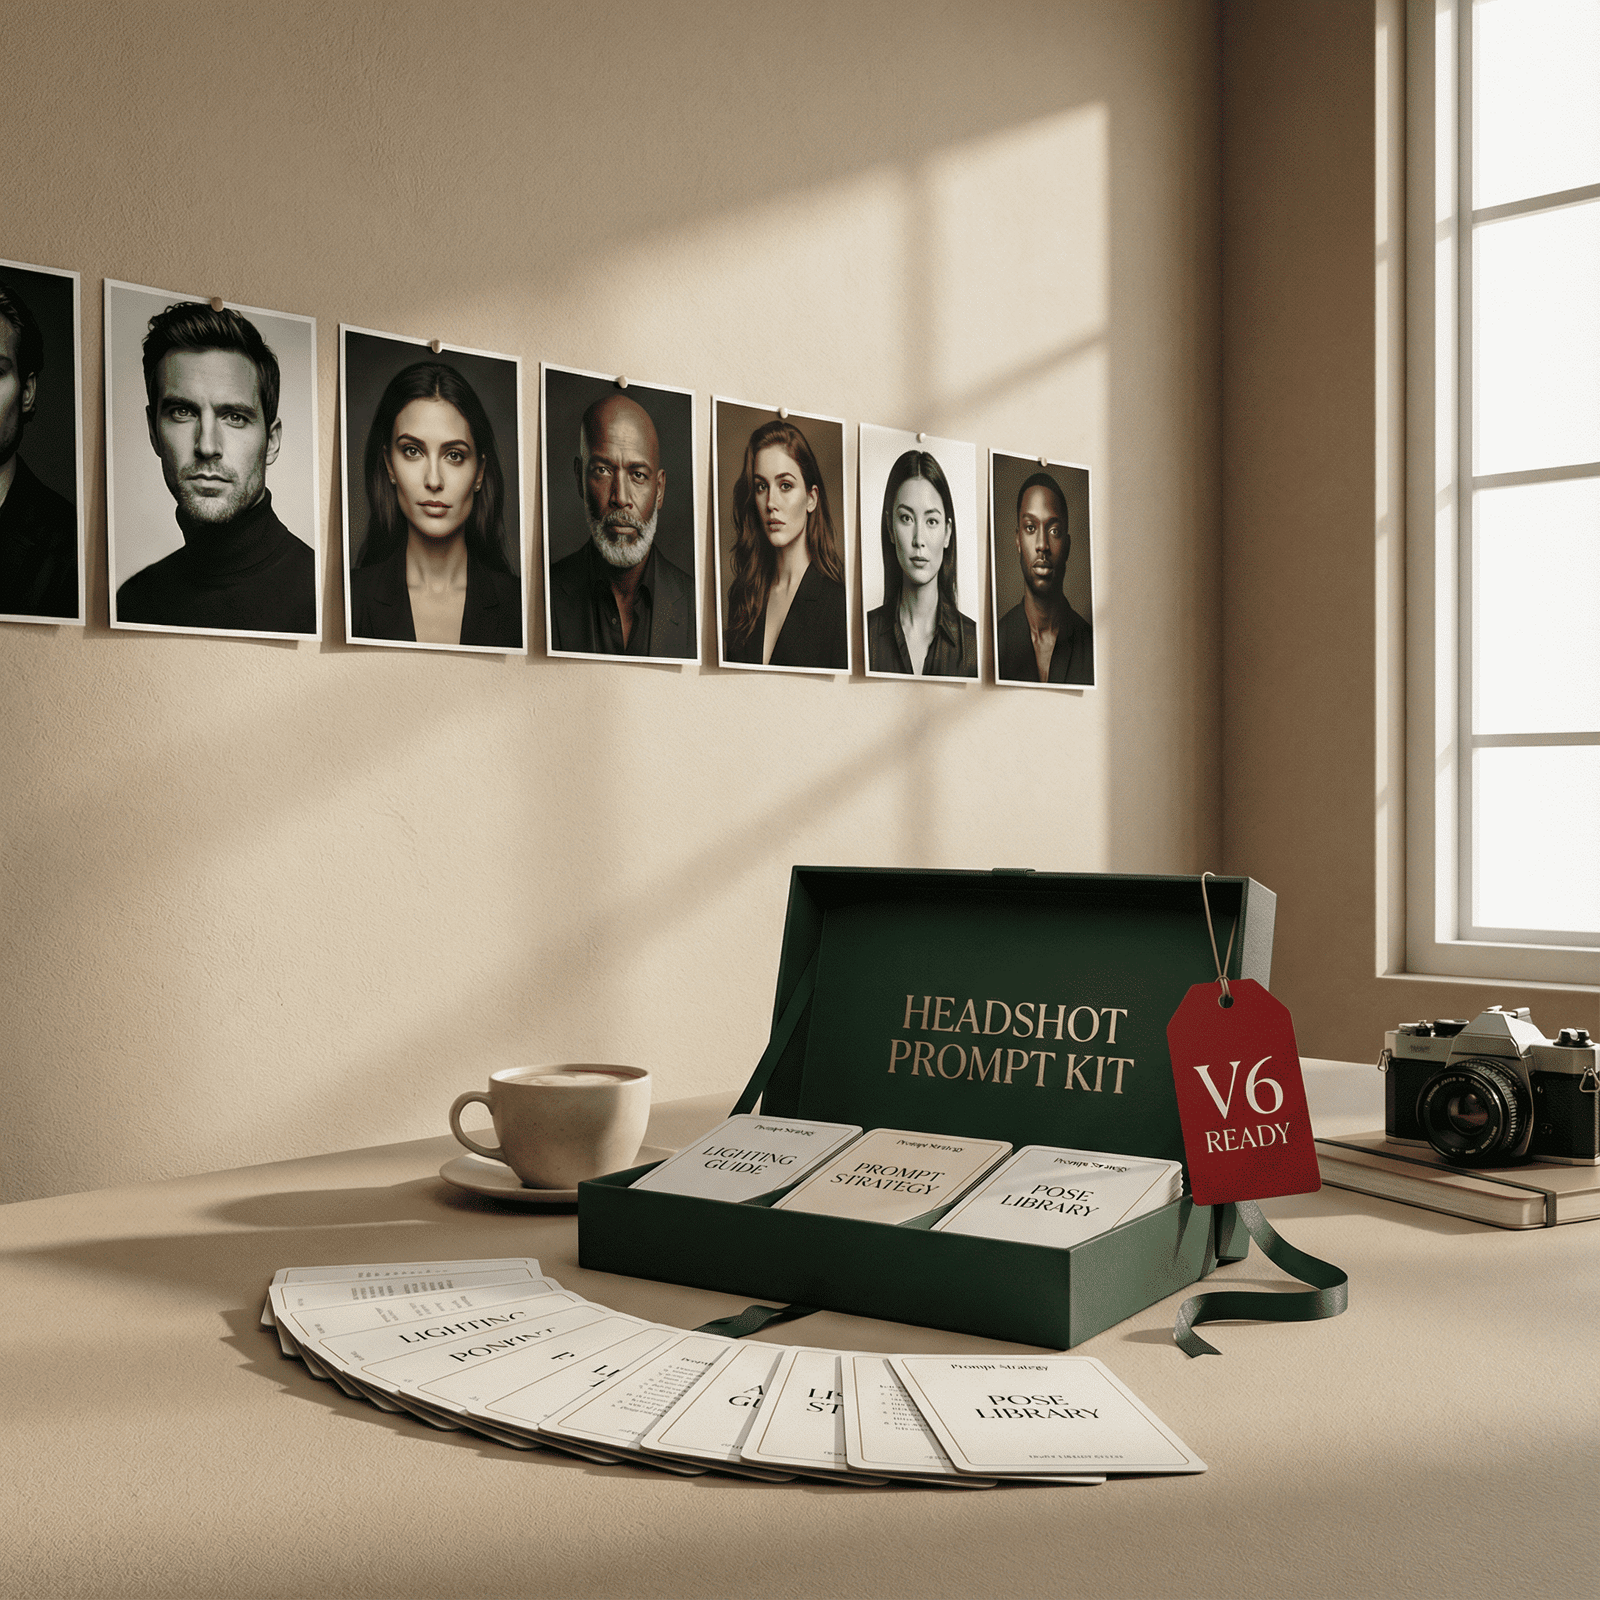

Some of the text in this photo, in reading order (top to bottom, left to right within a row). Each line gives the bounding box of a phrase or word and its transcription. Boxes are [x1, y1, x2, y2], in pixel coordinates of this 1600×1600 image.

[902, 994, 1128, 1044] HEADSHOT
[887, 1038, 1135, 1094] PROMPT KIT
[1193, 1055, 1284, 1120] V6
[1204, 1122, 1290, 1153] READY
[702, 1146, 797, 1166] LIGHTING
[703, 1159, 768, 1175] GUIDE
[853, 1162, 945, 1182] PROMPT
[830, 1173, 940, 1195] STRATEGY
[1030, 1184, 1094, 1202] POSE
[1000, 1194, 1100, 1217] LIBRARY
[987, 1394, 1070, 1406] POSE
[975, 1407, 1101, 1419] LIBRARY
